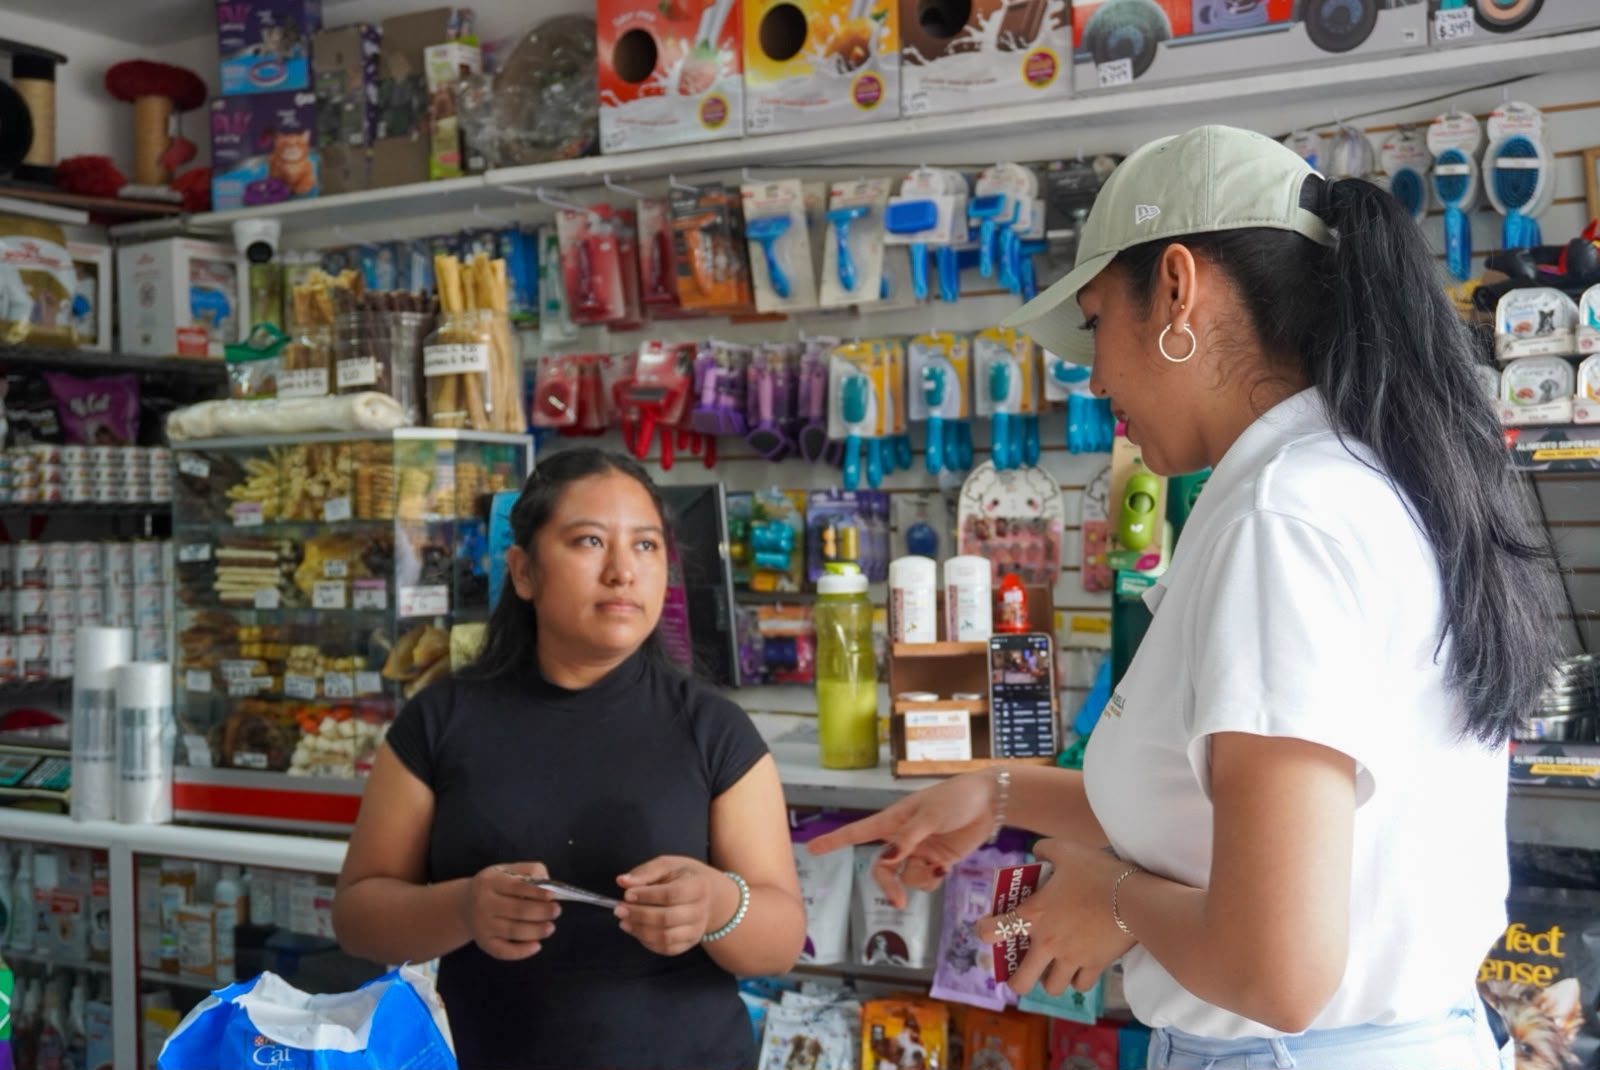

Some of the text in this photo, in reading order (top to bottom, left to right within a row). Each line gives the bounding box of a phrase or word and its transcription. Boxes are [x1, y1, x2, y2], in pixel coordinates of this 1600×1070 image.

[1516, 441, 1558, 452] ALIMENTO
[1558, 440, 1584, 449] SUPER
[1513, 755, 1555, 765] ALIMENTO
[1556, 757, 1581, 766] SUPER
[1493, 922, 1566, 958] fect
[252, 1045, 293, 1066] Cat
